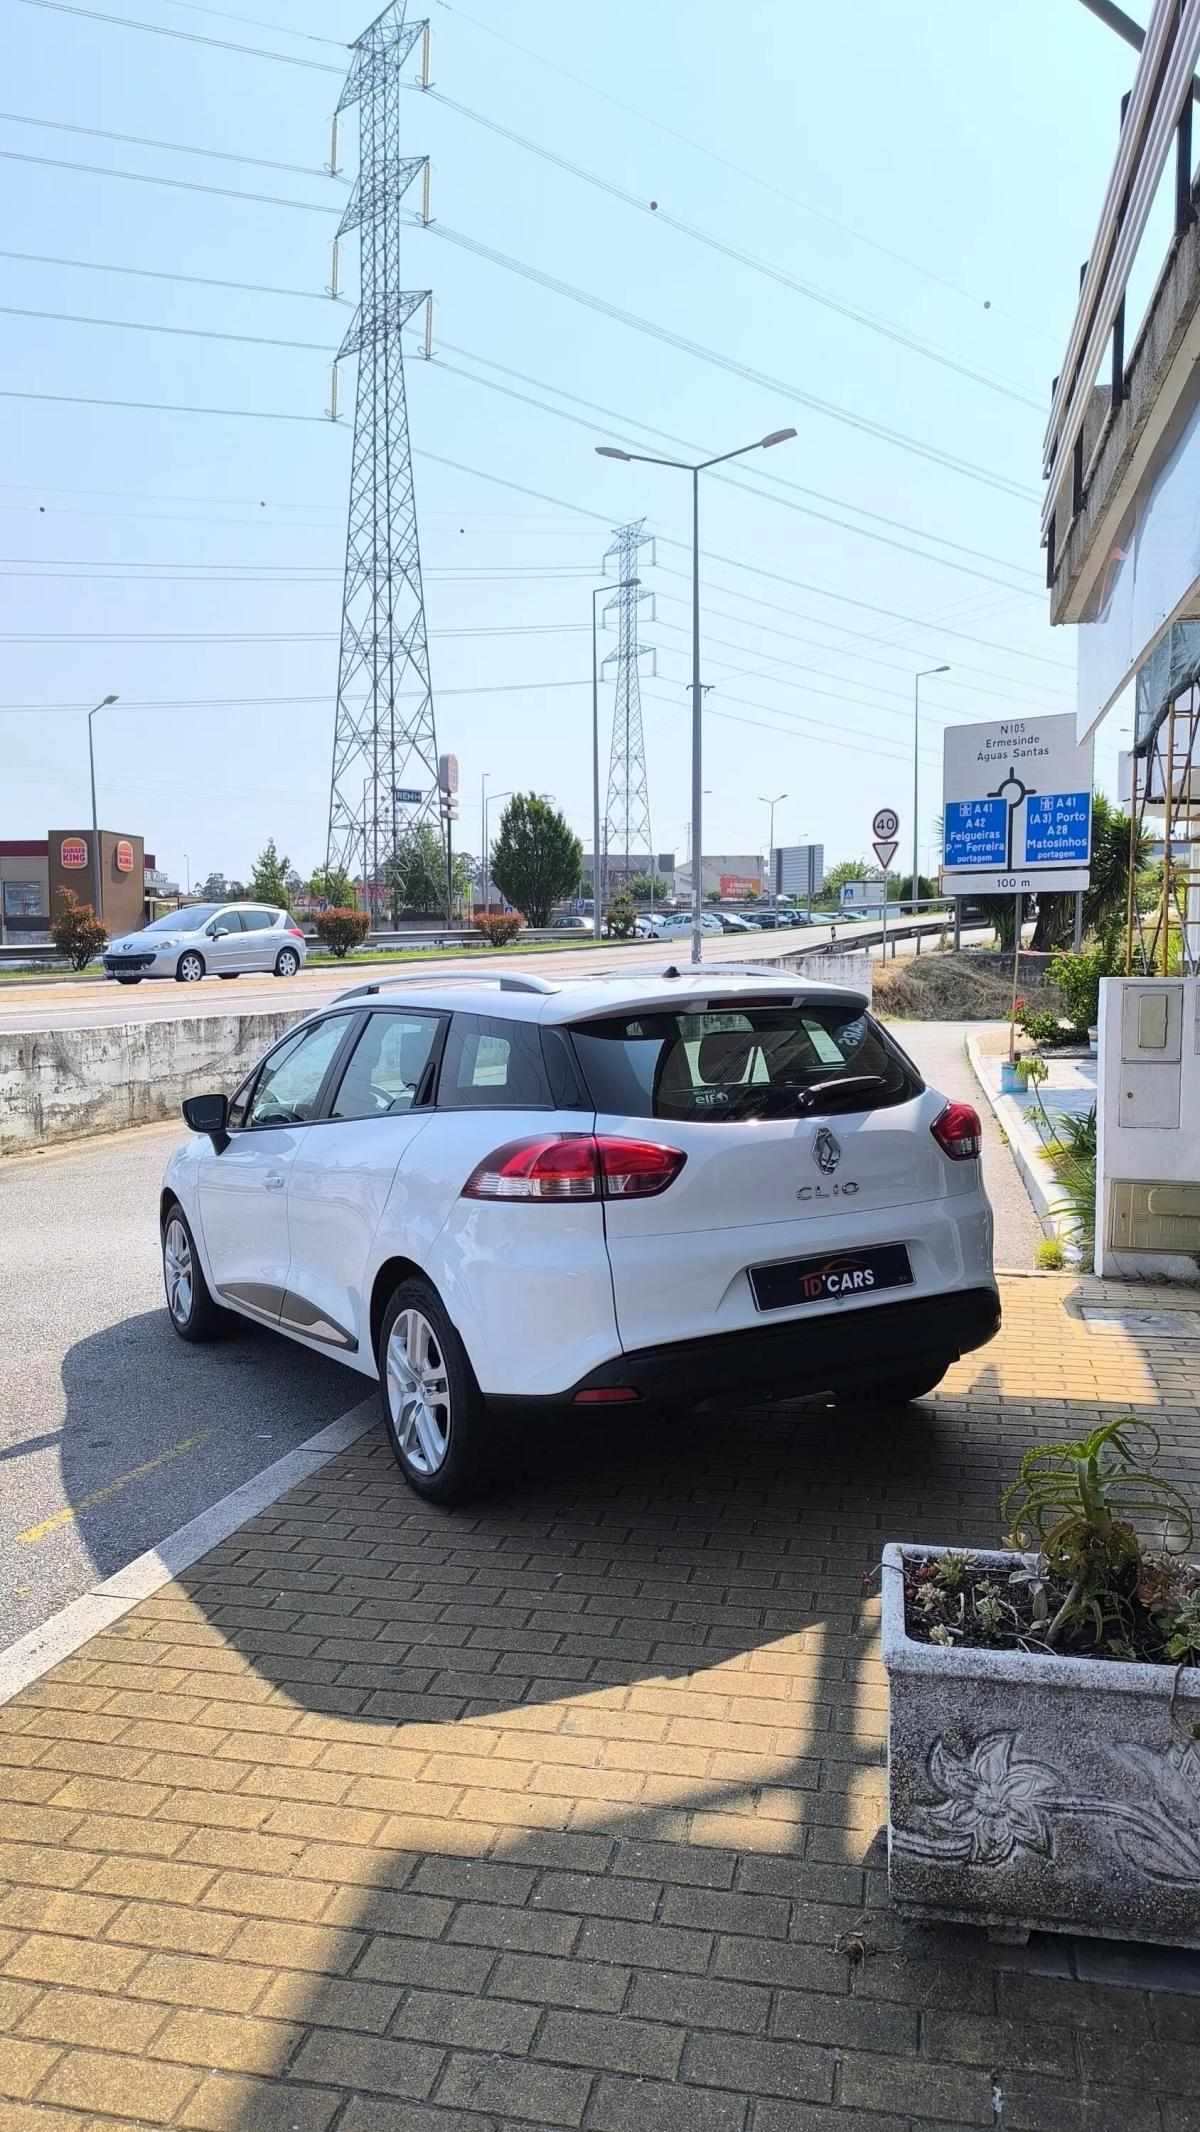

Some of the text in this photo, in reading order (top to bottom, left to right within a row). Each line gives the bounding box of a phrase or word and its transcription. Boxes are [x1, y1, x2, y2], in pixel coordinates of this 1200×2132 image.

[1000, 723, 1025, 734] N105
[985, 735, 1040, 748] Ermesinde
[1013, 747, 1049, 758] Santas
[1056, 811, 1086, 823] Porto
[877, 818, 895, 830] 40
[950, 830, 1001, 842] Felgueiras
[966, 841, 1005, 853] Ferreira
[1027, 837, 1087, 849] Matosinhos
[63, 853, 85, 862] KING
[997, 878, 1030, 888] 100 m
[796, 1182, 860, 1200] CLIO
